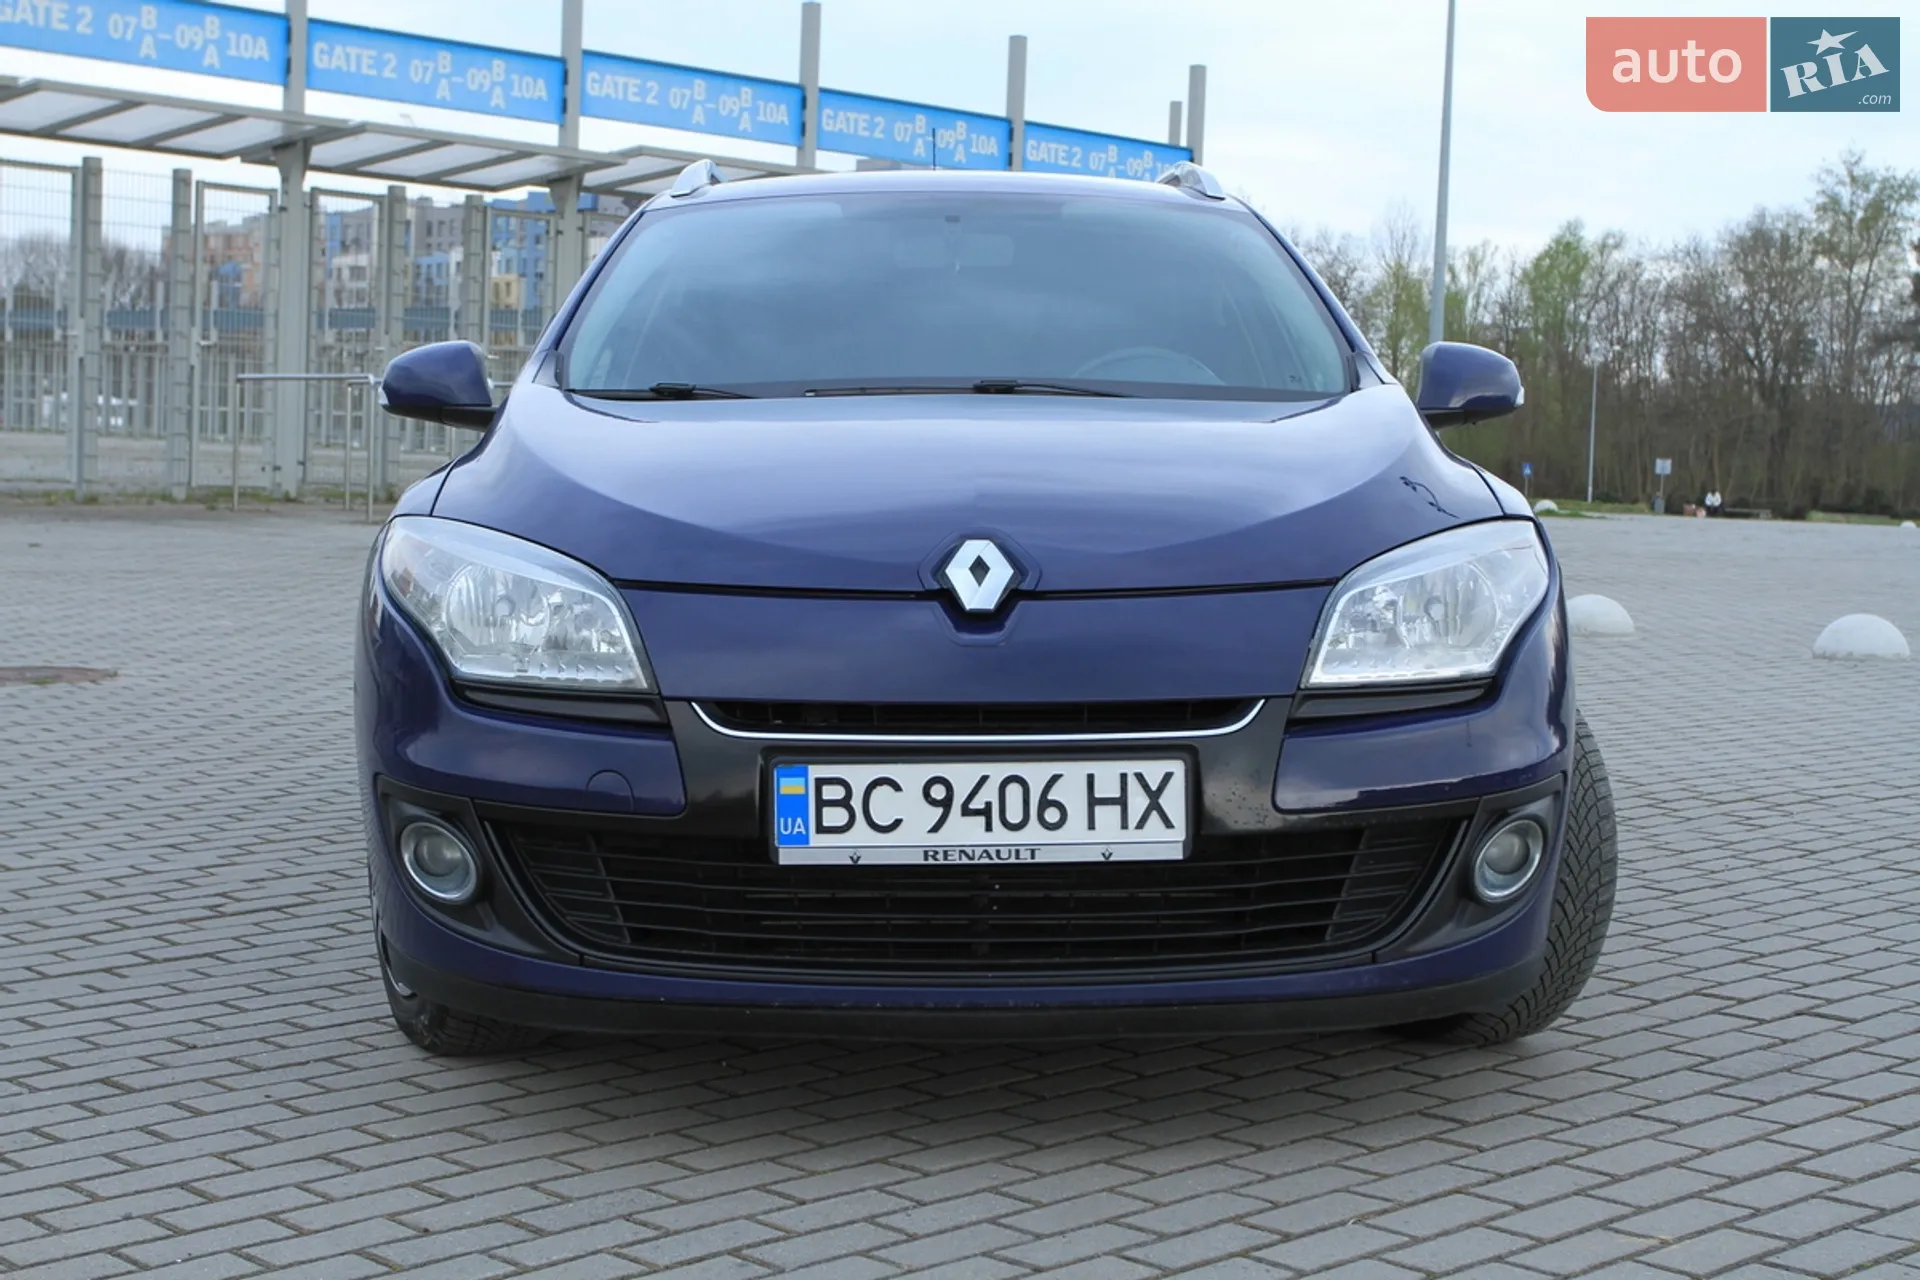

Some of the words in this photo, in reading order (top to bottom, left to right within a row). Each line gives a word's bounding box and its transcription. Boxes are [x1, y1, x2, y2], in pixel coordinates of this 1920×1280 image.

[76, 5, 93, 35] 2
[226, 32, 269, 61] 10A
[313, 42, 377, 76] GATE
[382, 53, 397, 78] 2
[510, 74, 548, 101] 10A
[586, 72, 641, 102] GATE
[646, 82, 659, 105] 2
[756, 101, 788, 125] 10A
[822, 109, 870, 136] GATE
[873, 116, 885, 139] 2
[970, 134, 998, 156] 10A
[1026, 140, 1069, 166] GATE
[1071, 147, 1082, 168] 2
[780, 818, 806, 835] UA
[814, 776, 904, 835] BC
[922, 774, 1069, 833] 9406
[1086, 771, 1176, 831] HX
[922, 848, 1042, 862] RENAULT
